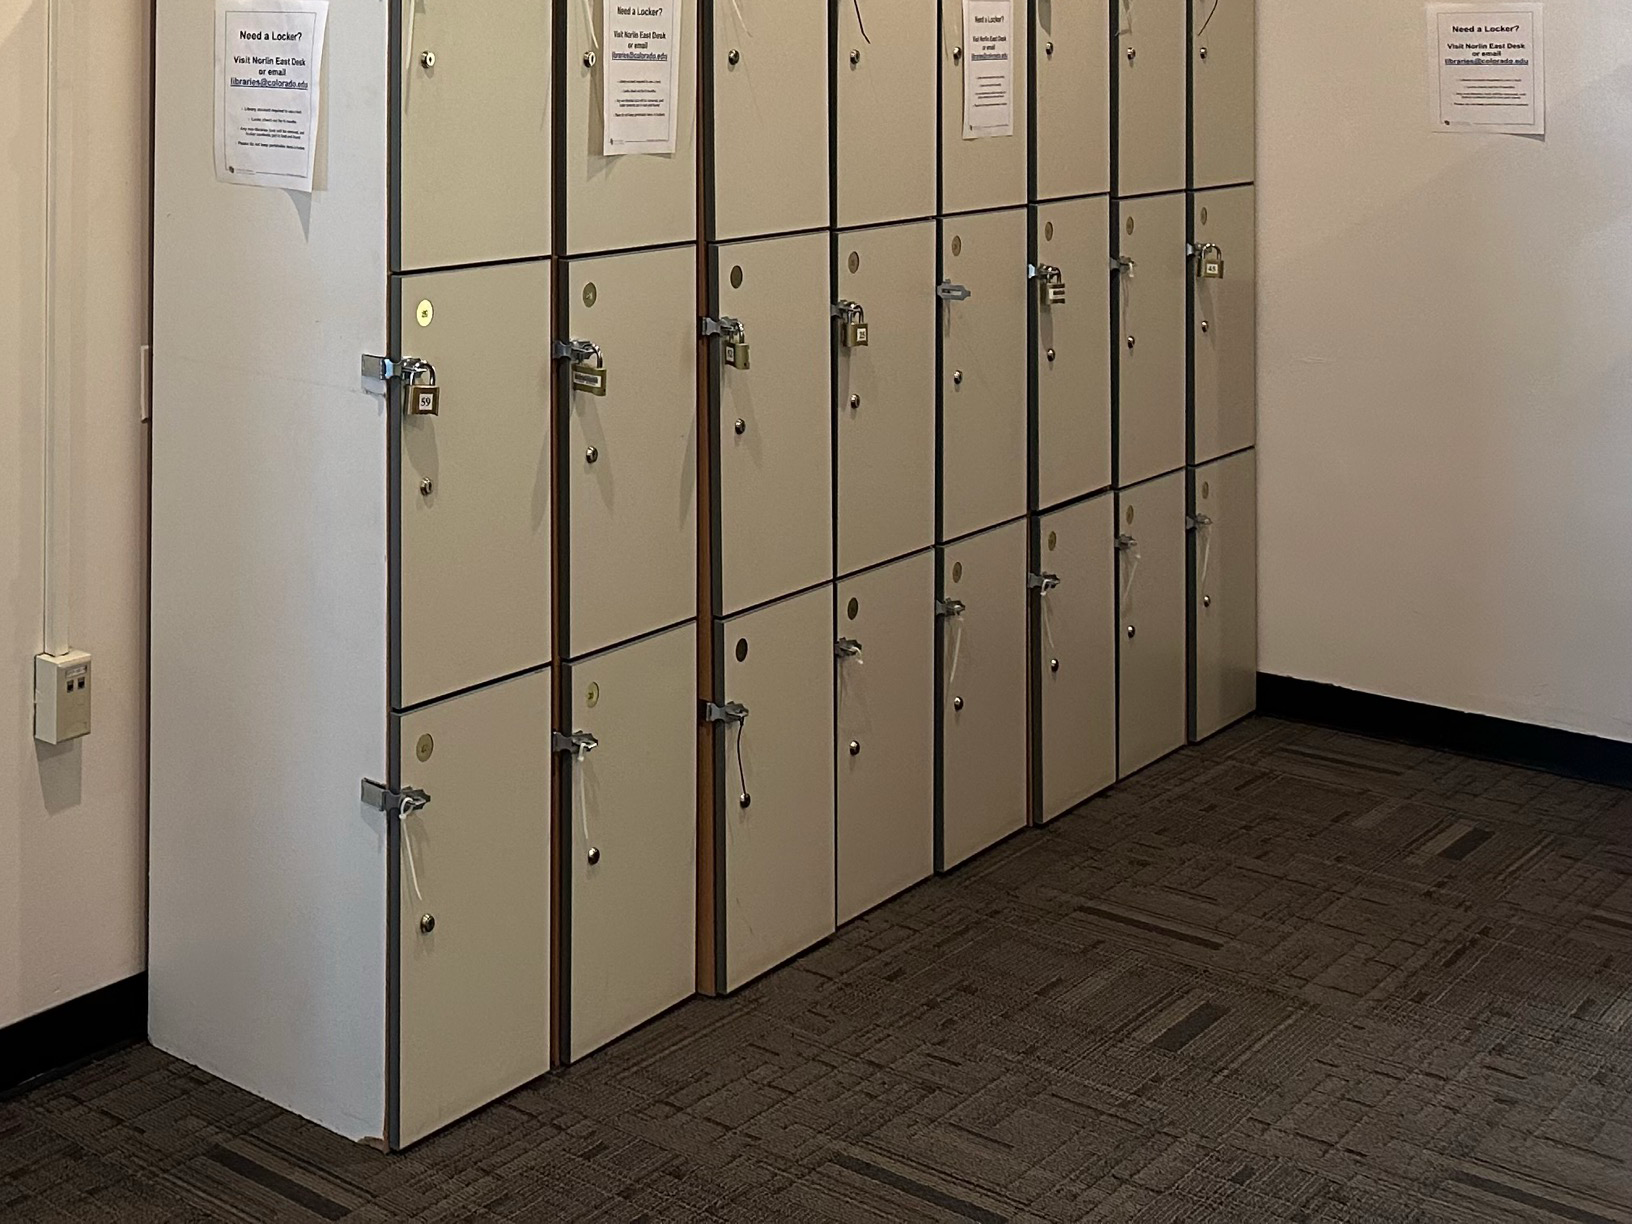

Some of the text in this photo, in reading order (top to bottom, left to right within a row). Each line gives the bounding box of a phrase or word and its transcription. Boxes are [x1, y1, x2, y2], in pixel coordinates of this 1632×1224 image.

[617, 6, 631, 15] Need
[637, 7, 663, 16] Locker?
[1484, 25, 1520, 33] Locker?
[239, 30, 303, 41] Need a Locker?
[234, 56, 306, 66] Visit Norlin East Desk
[268, 68, 286, 76] email
[421, 396, 431, 407] 59
